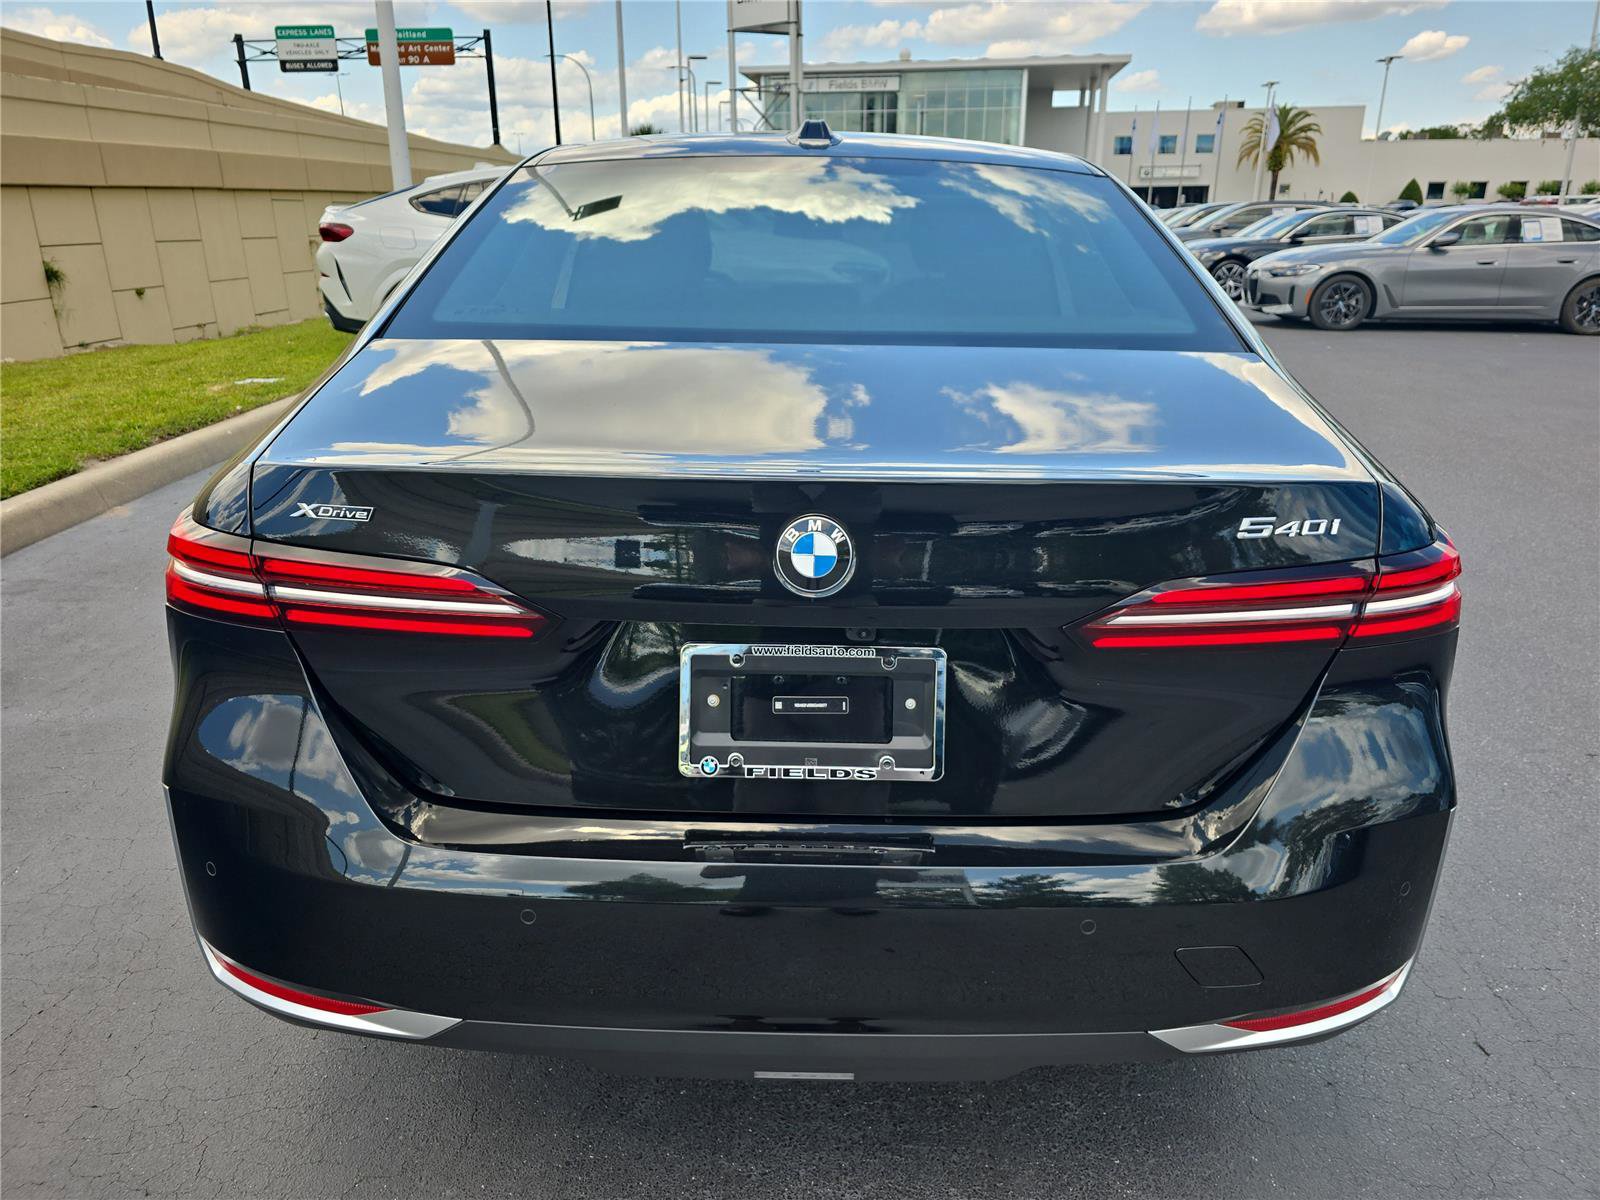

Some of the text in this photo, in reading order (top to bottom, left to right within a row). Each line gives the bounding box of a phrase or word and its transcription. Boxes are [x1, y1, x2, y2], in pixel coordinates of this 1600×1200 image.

[277, 28, 332, 36] EXPRESS LANES
[396, 30, 427, 39] aitland
[408, 44, 421, 53] Art
[424, 44, 450, 53] Center
[407, 55, 420, 63] 90
[423, 55, 430, 63] A
[285, 61, 333, 70] BUSES ALLOWED
[784, 519, 846, 544] BMW
[752, 645, 876, 657] www.fieldsauto.com
[745, 766, 878, 780] FIELDS
